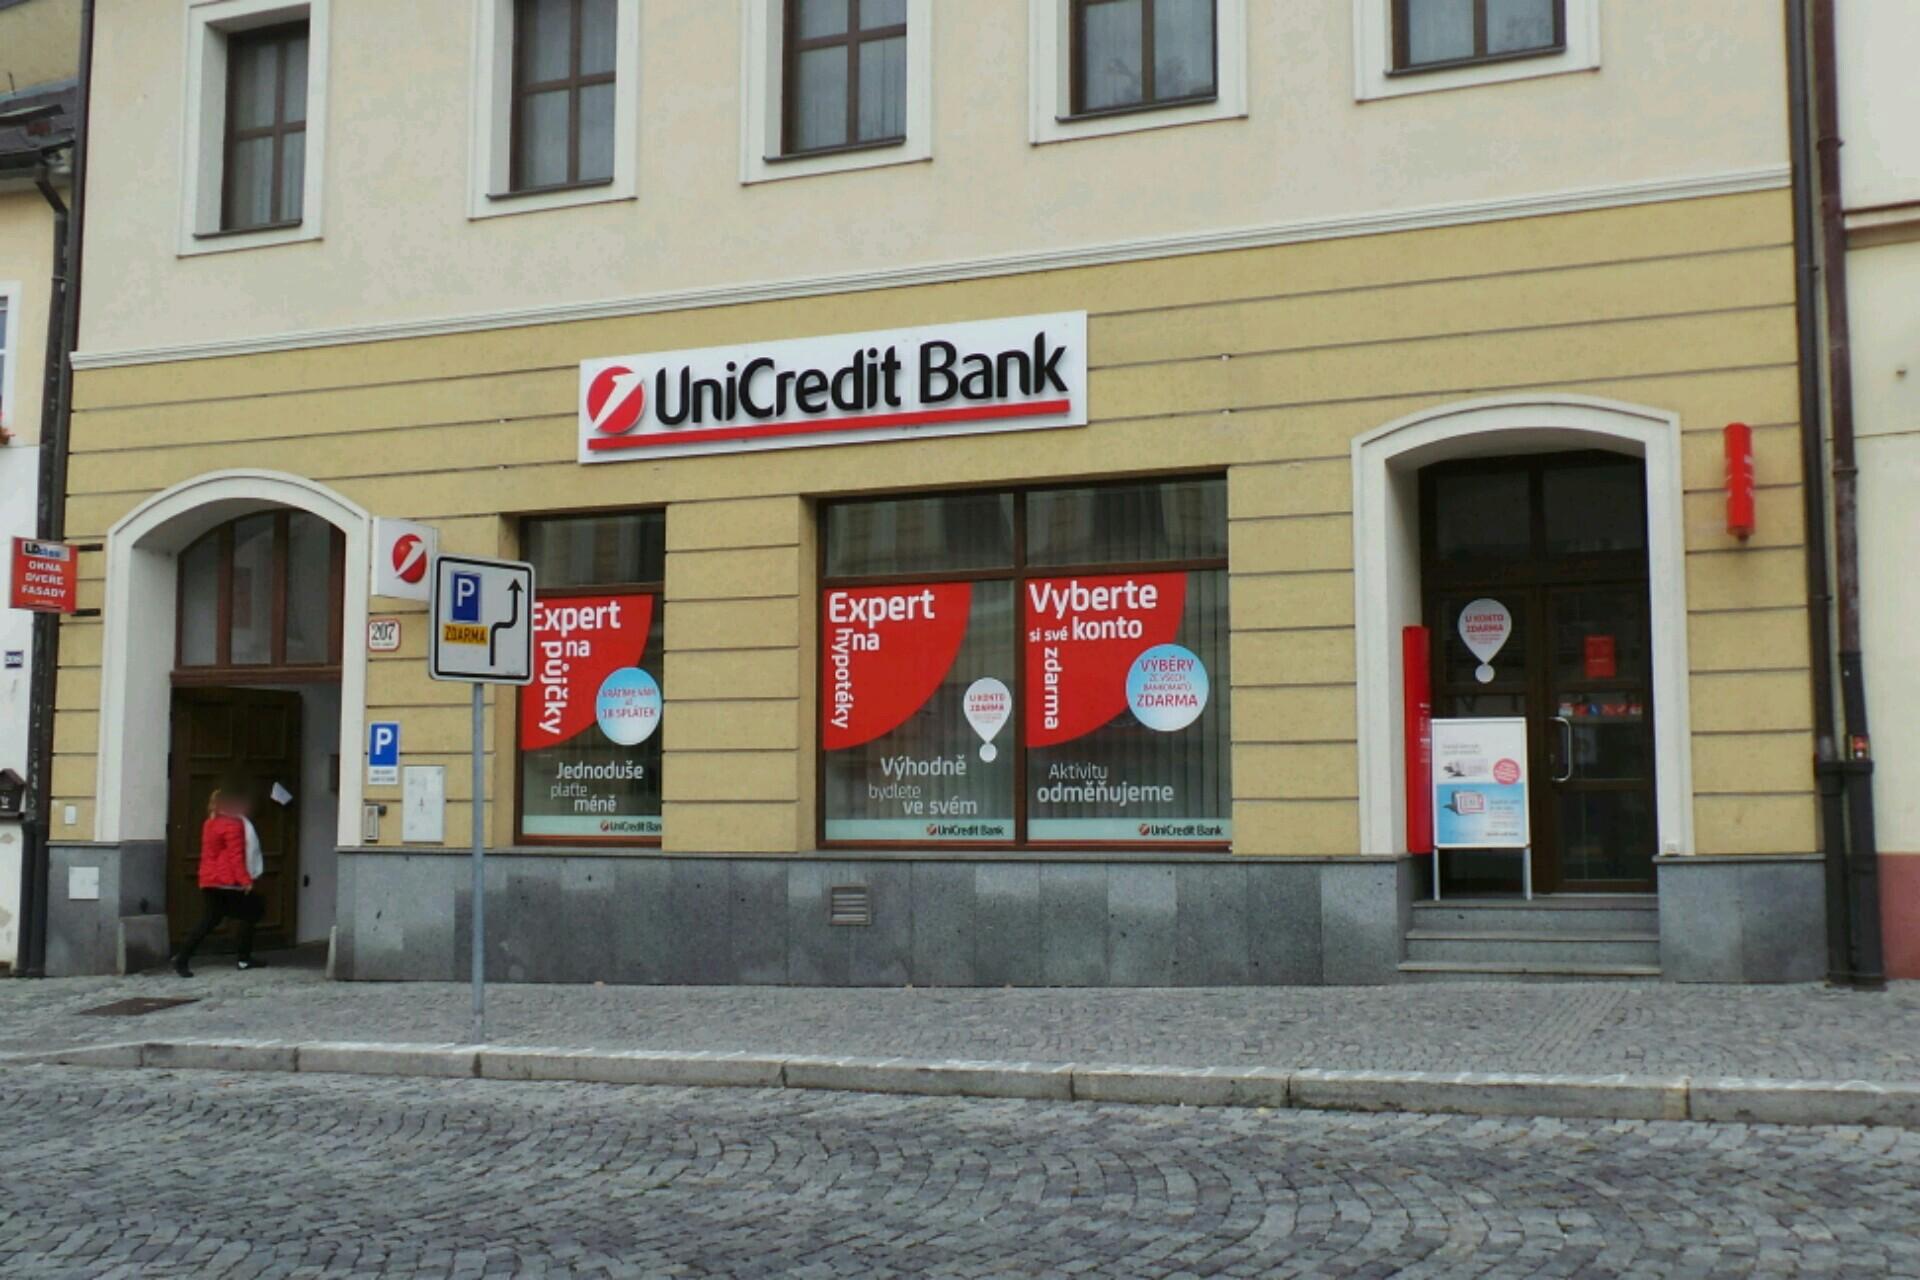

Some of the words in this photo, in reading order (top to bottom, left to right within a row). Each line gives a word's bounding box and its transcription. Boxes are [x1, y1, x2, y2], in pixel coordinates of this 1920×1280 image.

[655, 345, 901, 426] UniCredit
[919, 331, 1068, 404] Bank
[457, 578, 475, 607] P
[1029, 580, 1158, 620] Vyberte
[533, 600, 621, 638] Expert
[829, 589, 935, 629] Expert
[371, 623, 396, 641] 207
[444, 625, 486, 643] ZDARMA
[1029, 627, 1041, 642] si
[1044, 626, 1068, 641] své
[1072, 616, 1143, 641] konto
[1466, 623, 1504, 633] ZDARMA
[566, 640, 590, 657] na
[852, 631, 880, 651] na
[1141, 655, 1194, 672] VÝBĚRY
[539, 641, 570, 734] půjčky
[831, 628, 854, 729] hypotéky
[1044, 647, 1063, 730] zdarma
[969, 704, 1005, 712] ZDARMA
[1136, 693, 1199, 708] ZDARMA
[375, 728, 393, 756] P
[556, 760, 643, 779] Jednoduše
[880, 754, 967, 781] Výhodně
[868, 783, 921, 801] bydlete
[1037, 781, 1175, 807] odměňujeme
[574, 794, 616, 812] méně
[903, 801, 923, 815] ve
[929, 795, 977, 815] svém
[610, 821, 644, 832] UniCredit
[938, 825, 979, 836] UniCredit
[981, 825, 1004, 836] Bank
[1151, 825, 1195, 836] UniCredit
[1197, 825, 1223, 836] Bank
